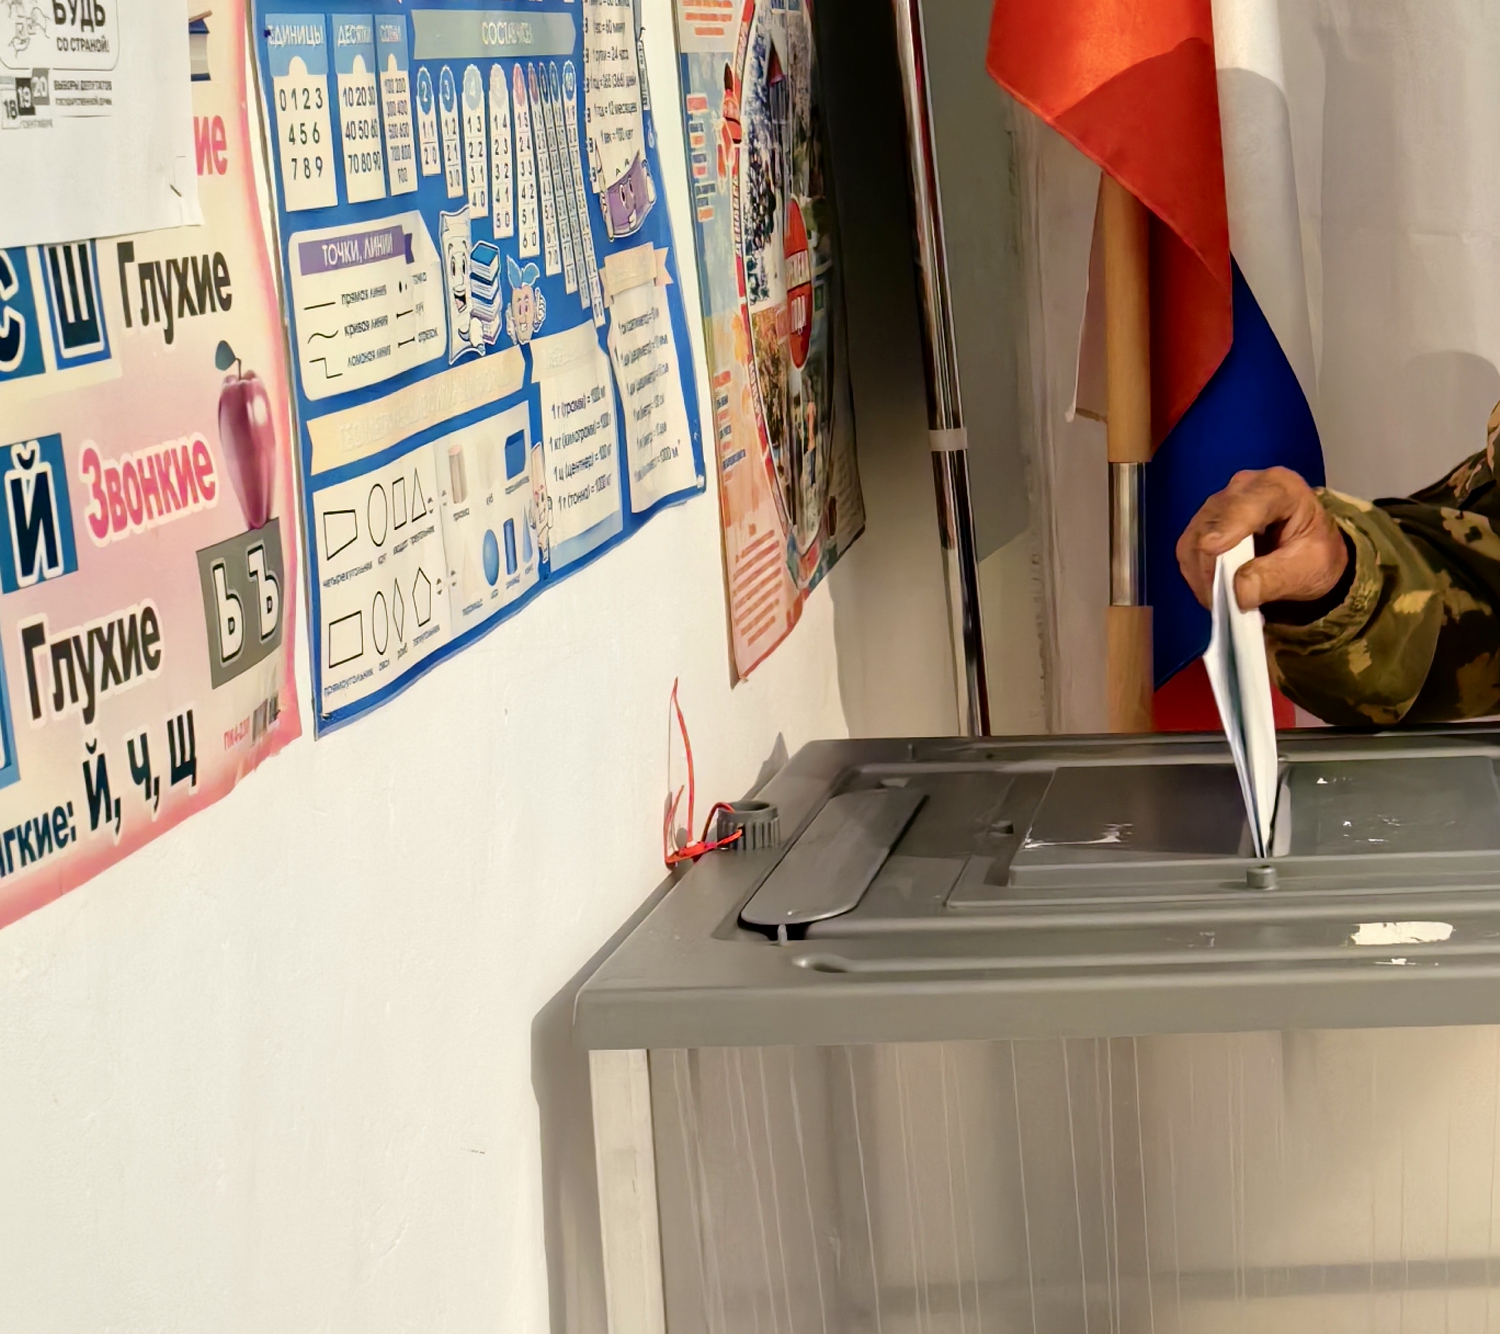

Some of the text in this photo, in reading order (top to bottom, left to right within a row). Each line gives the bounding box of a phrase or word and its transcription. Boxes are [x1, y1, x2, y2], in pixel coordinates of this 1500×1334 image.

[57, 38, 69, 52] СО
[3, 98, 18, 120] 18
[17, 85, 32, 109] 19
[31, 75, 48, 98] 20
[279, 87, 323, 111] 0 1 2 3
[343, 87, 354, 107] 10
[355, 86, 367, 106] 20
[288, 122, 320, 145] 4 5 6
[345, 120, 357, 141] 40
[358, 120, 369, 140] 50
[291, 156, 323, 180] 7 8 9
[348, 154, 359, 174] 70
[361, 152, 372, 173] 80
[116, 241, 233, 345] Глухие
[82, 438, 216, 541] Звонкие
[10, 449, 59, 578] Й
[20, 605, 162, 725] Глухие
[0, 800, 77, 878] гкие:
